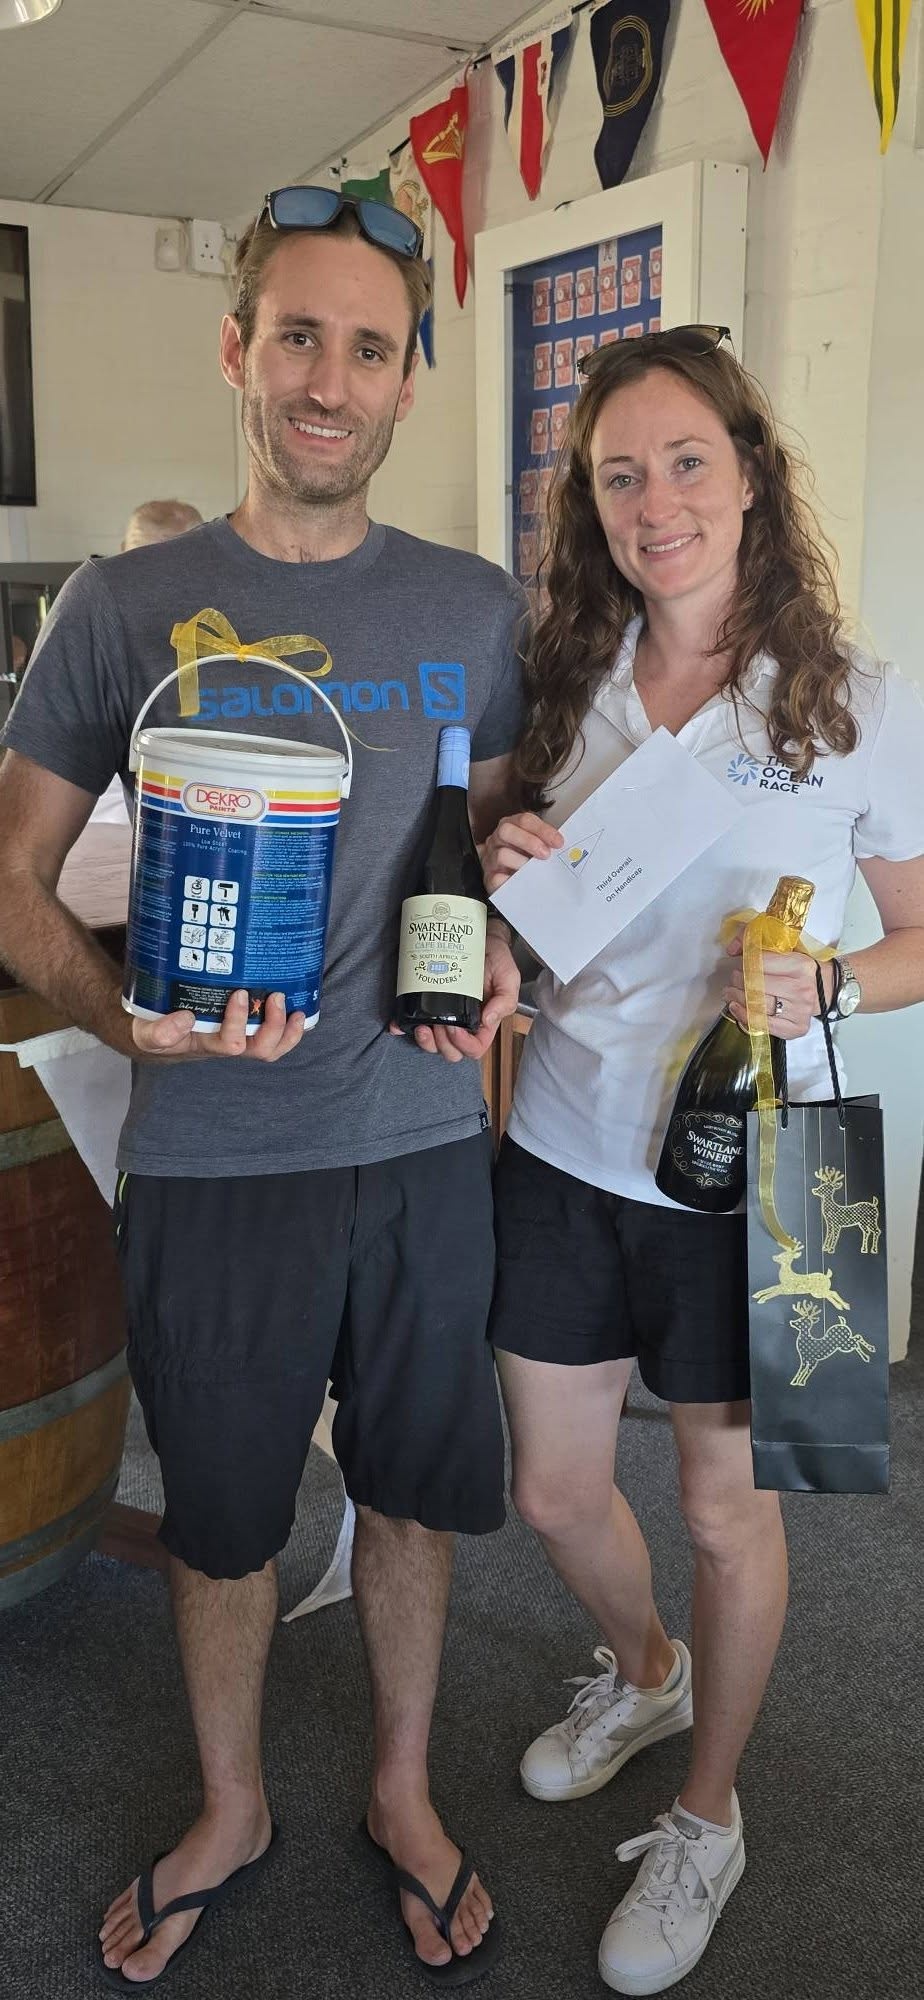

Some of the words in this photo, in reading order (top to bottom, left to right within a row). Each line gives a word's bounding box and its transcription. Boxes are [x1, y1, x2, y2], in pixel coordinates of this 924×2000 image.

[191, 680, 410, 721] salomon
[759, 779, 800, 794] RACE
[196, 788, 251, 808] DEKRO
[209, 804, 236, 813] PAINTS
[190, 823, 211, 836] Pure
[213, 827, 242, 839] Velvet
[596, 875, 613, 892] Third
[611, 856, 633, 878] Overall
[605, 892, 616, 903] On
[614, 867, 643, 894] Handicap
[408, 922, 474, 936] SWARTLAND
[417, 932, 464, 943] WINERY
[418, 973, 458, 985] FOUNDERS
[693, 1144, 736, 1164] WINERY
